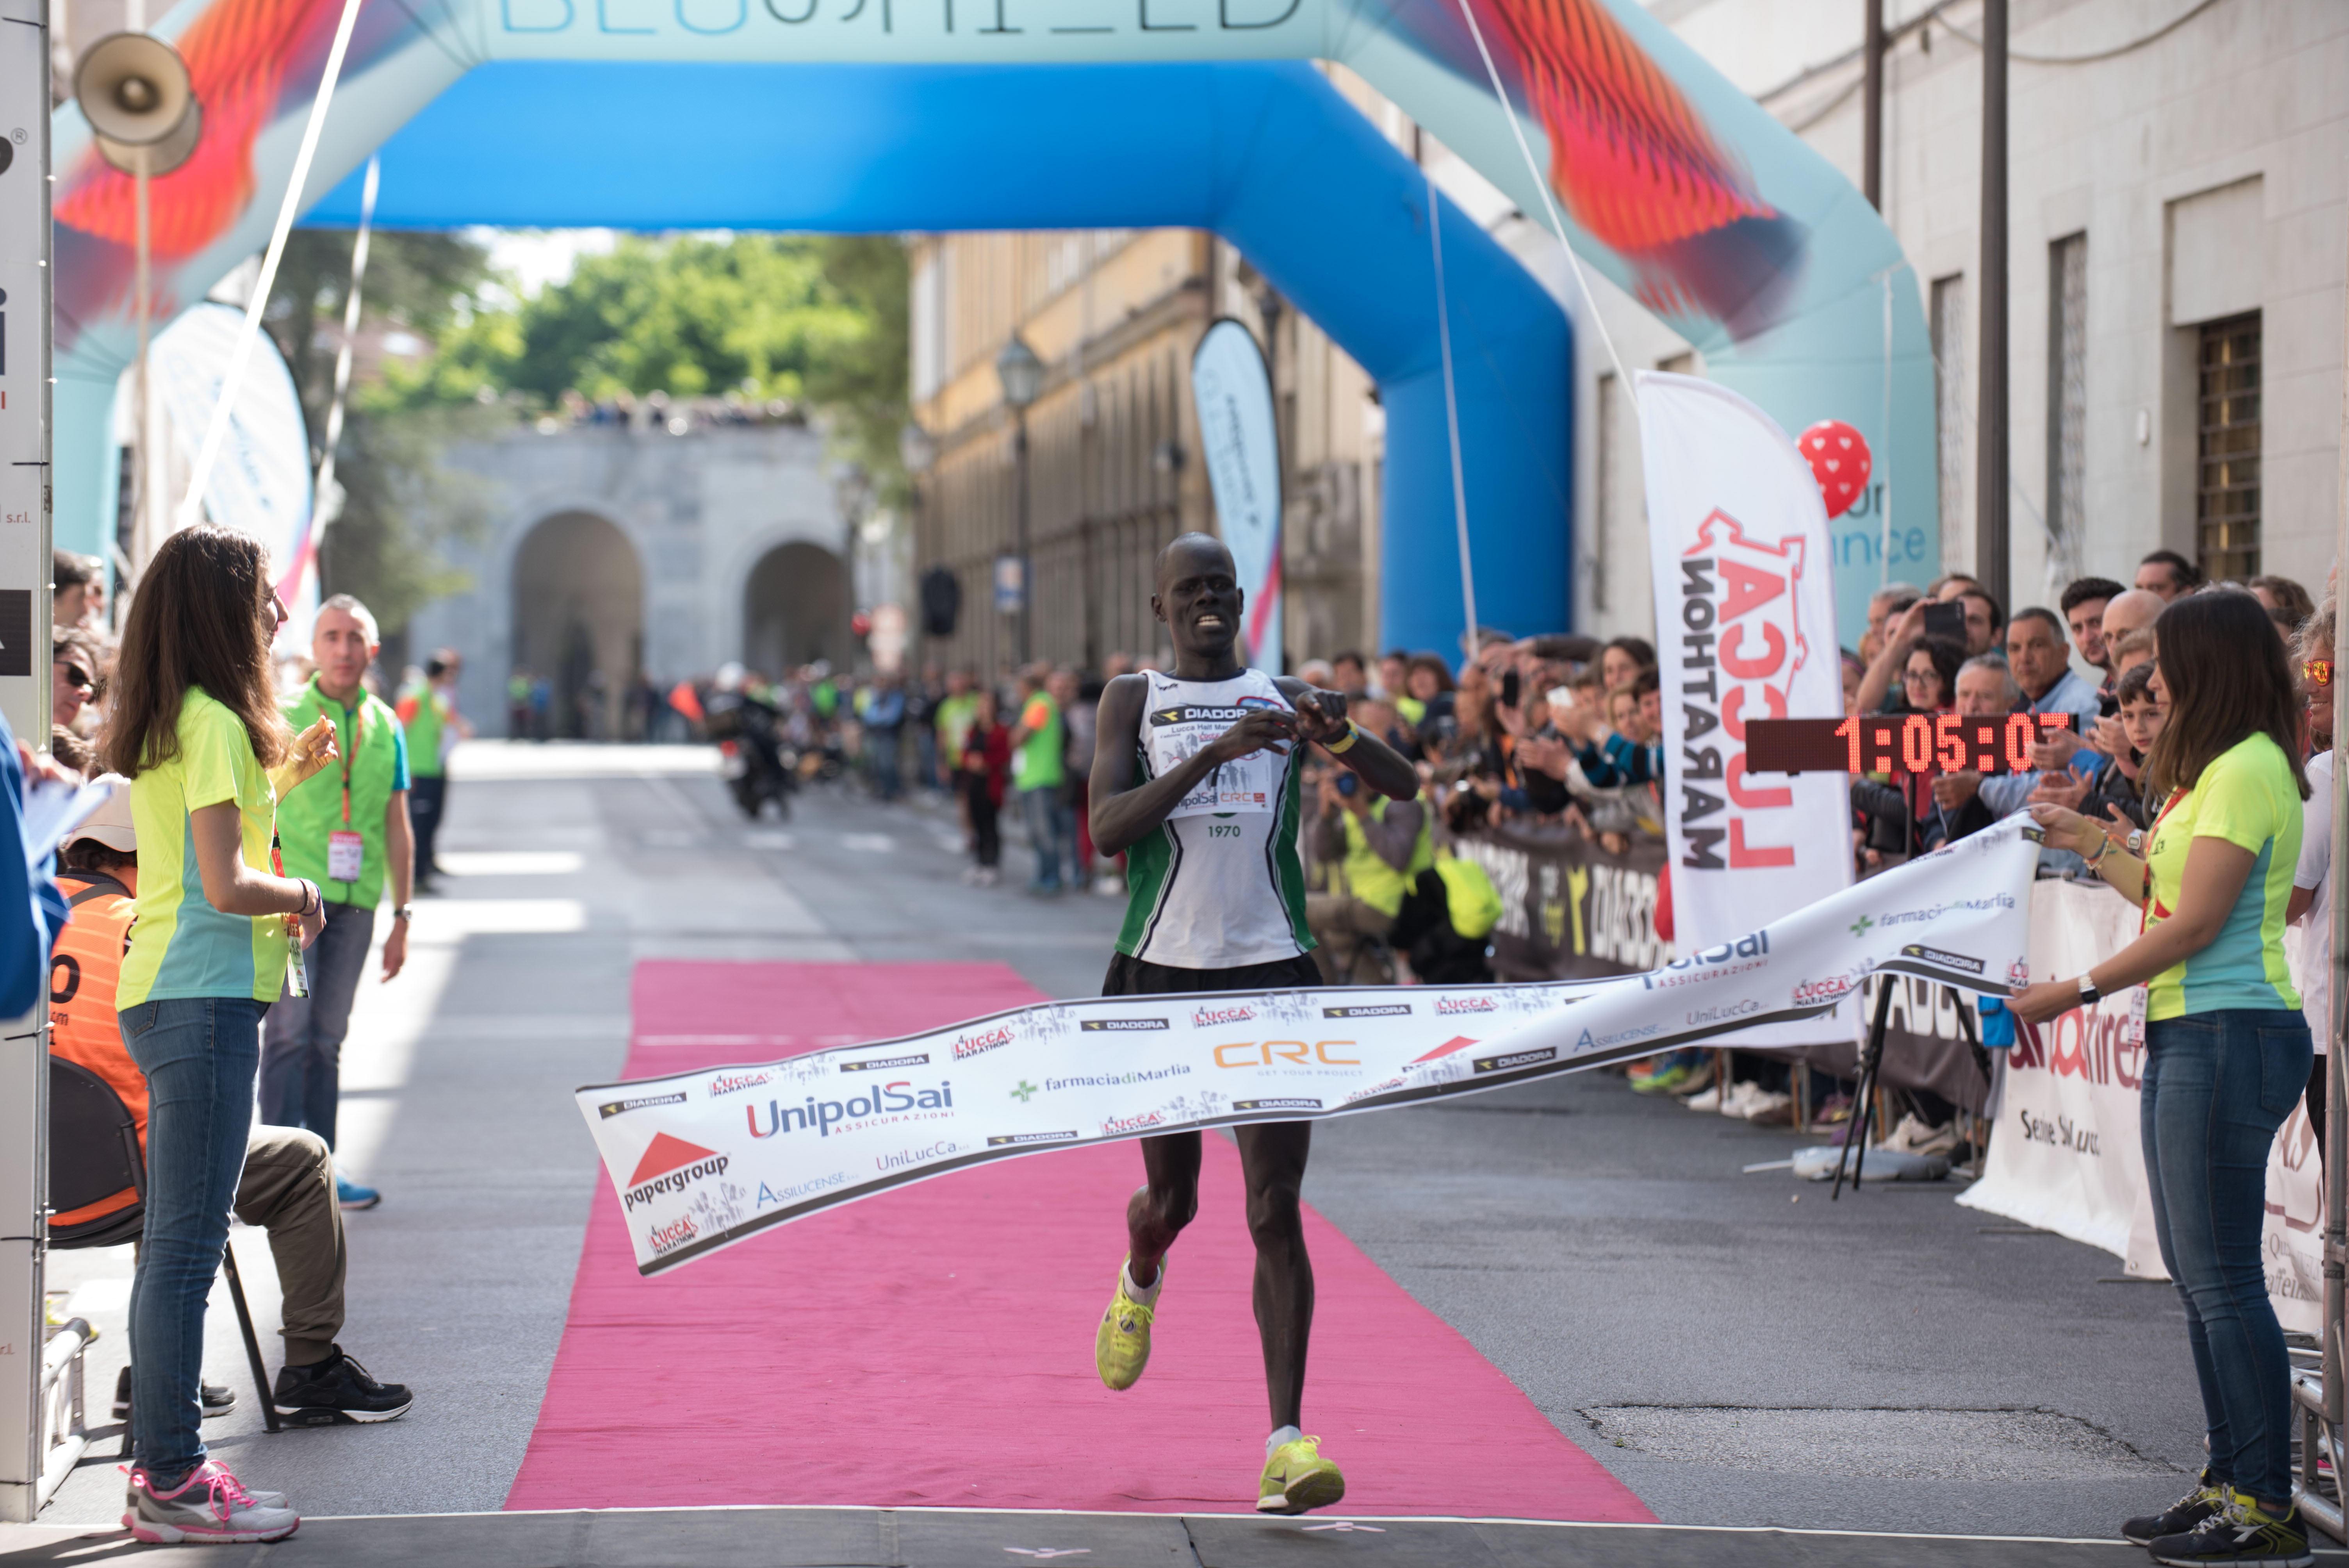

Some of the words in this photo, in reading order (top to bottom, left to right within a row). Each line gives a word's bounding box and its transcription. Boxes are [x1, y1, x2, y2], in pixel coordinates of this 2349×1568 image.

[6, 512, 31, 523] s.r.l.
[1832, 526, 1926, 565] nce
[1835, 713, 2068, 773] 1:05:0
[1220, 793, 1252, 802] CRC
[1208, 825, 1240, 837] 1970
[1924, 950, 1981, 972] DIADORA
[1659, 959, 1768, 988] ASSICURAZIONI
[1795, 980, 1846, 999] LUCCA
[1797, 991, 1850, 1005] MARATHON
[1348, 1006, 1408, 1016] DIADORA
[1438, 998, 1490, 1010] LUCCA
[1686, 998, 1759, 1025] UniLucCa
[1106, 1020, 1166, 1030] DIADORA
[1196, 1008, 1249, 1023] LUCCA
[1198, 1016, 1251, 1028] MARATHON
[955, 1029, 1007, 1054] LUCCA
[957, 1039, 1009, 1060] MARATHON
[865, 1055, 926, 1070] DIADORA
[1212, 1040, 1362, 1069] CRC
[1497, 1048, 1554, 1068] DIADORA
[713, 1074, 766, 1090] LUCCA
[1045, 1064, 1191, 1092] farmaciadiMarlia
[714, 1080, 767, 1097] MARATHON
[623, 1094, 683, 1110] DIADORA
[747, 1080, 953, 1139] UnipolSai
[1258, 1099, 1319, 1108] DIADORA
[835, 1111, 955, 1135] ASSICURAZIONI
[1105, 1113, 1158, 1132] LUCCA
[1106, 1121, 1160, 1136] MARATHON
[1014, 1131, 1075, 1143] DIADORA
[875, 1141, 956, 1171] UniLucCa
[624, 1155, 729, 1213] papergroup
[651, 1219, 694, 1247] LUCCA
[656, 1232, 695, 1254] MARATHON
